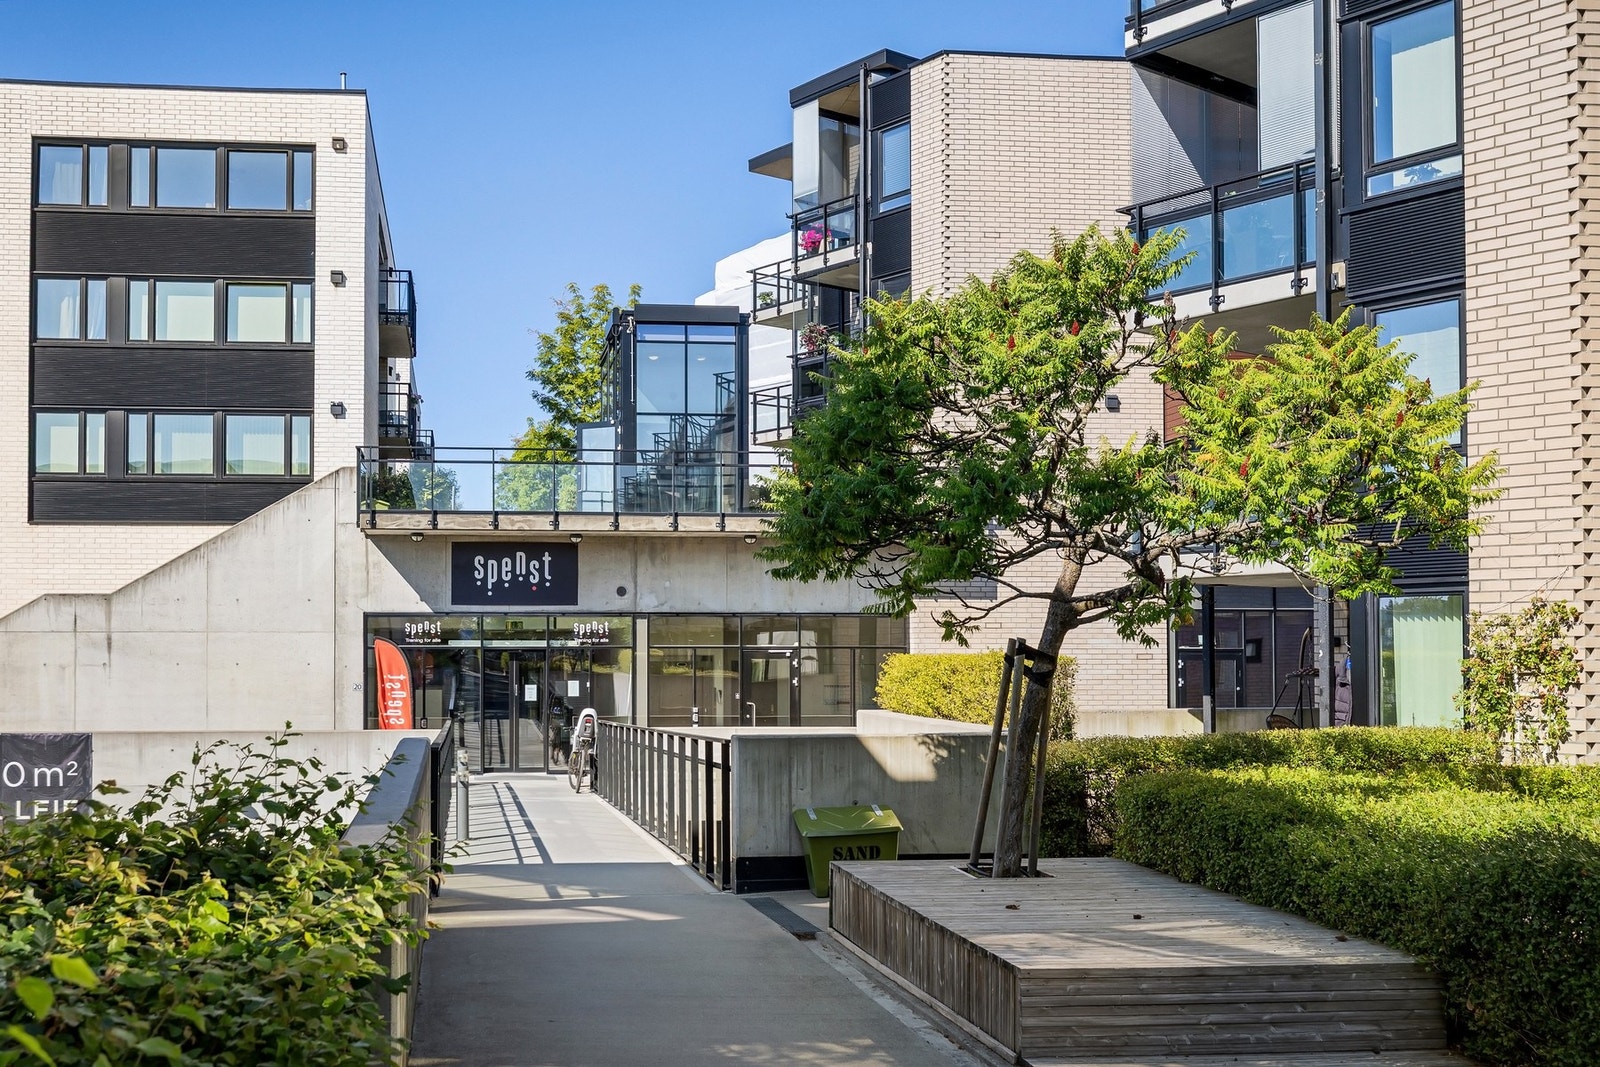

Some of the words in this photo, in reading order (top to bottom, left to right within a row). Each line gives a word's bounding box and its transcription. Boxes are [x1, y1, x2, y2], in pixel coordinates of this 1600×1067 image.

[474, 551, 552, 592] spenst
[405, 621, 441, 637] spenst
[573, 621, 609, 637] spenst
[833, 846, 881, 860] SAND
